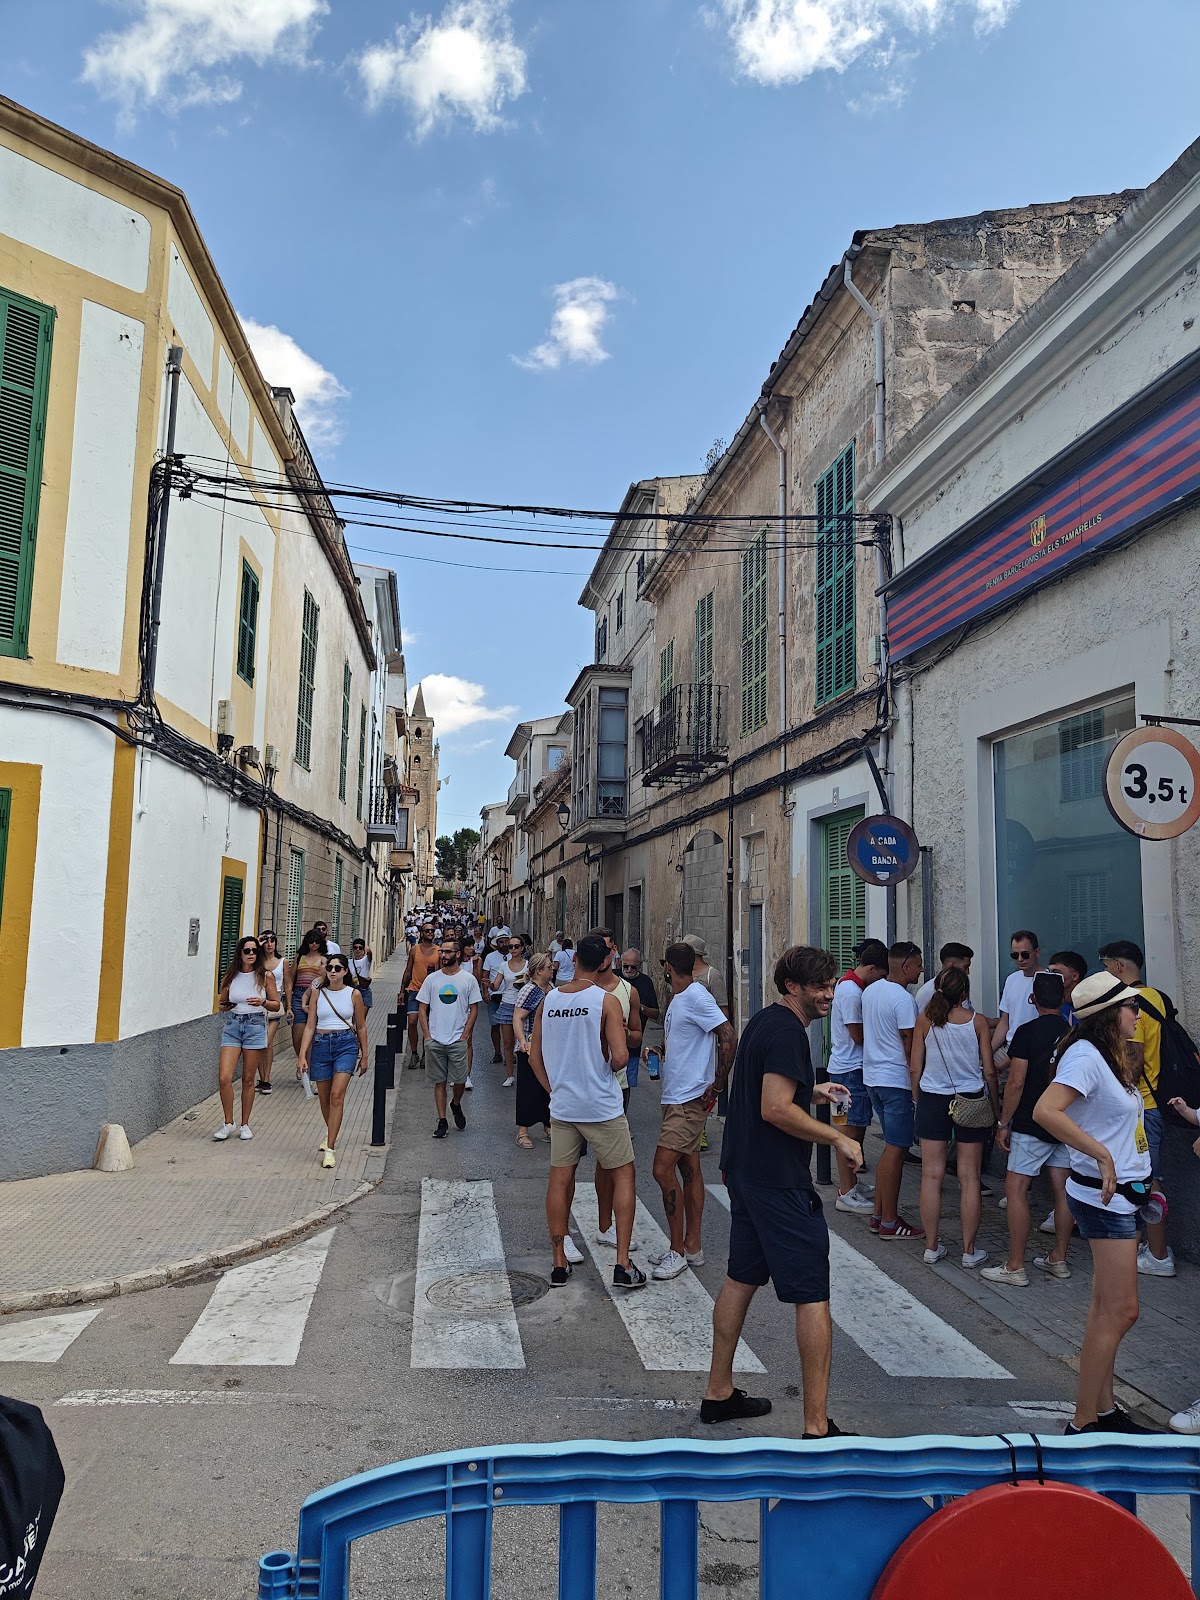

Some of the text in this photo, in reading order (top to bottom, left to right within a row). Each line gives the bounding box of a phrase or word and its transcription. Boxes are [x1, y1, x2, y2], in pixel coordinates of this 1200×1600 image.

[985, 513, 1102, 590] PENYA BARCELONISTA ELS TAMARELLS
[870, 836, 897, 845] A CADA
[872, 856, 898, 865] BANDA
[547, 1007, 589, 1018] CARLOS
